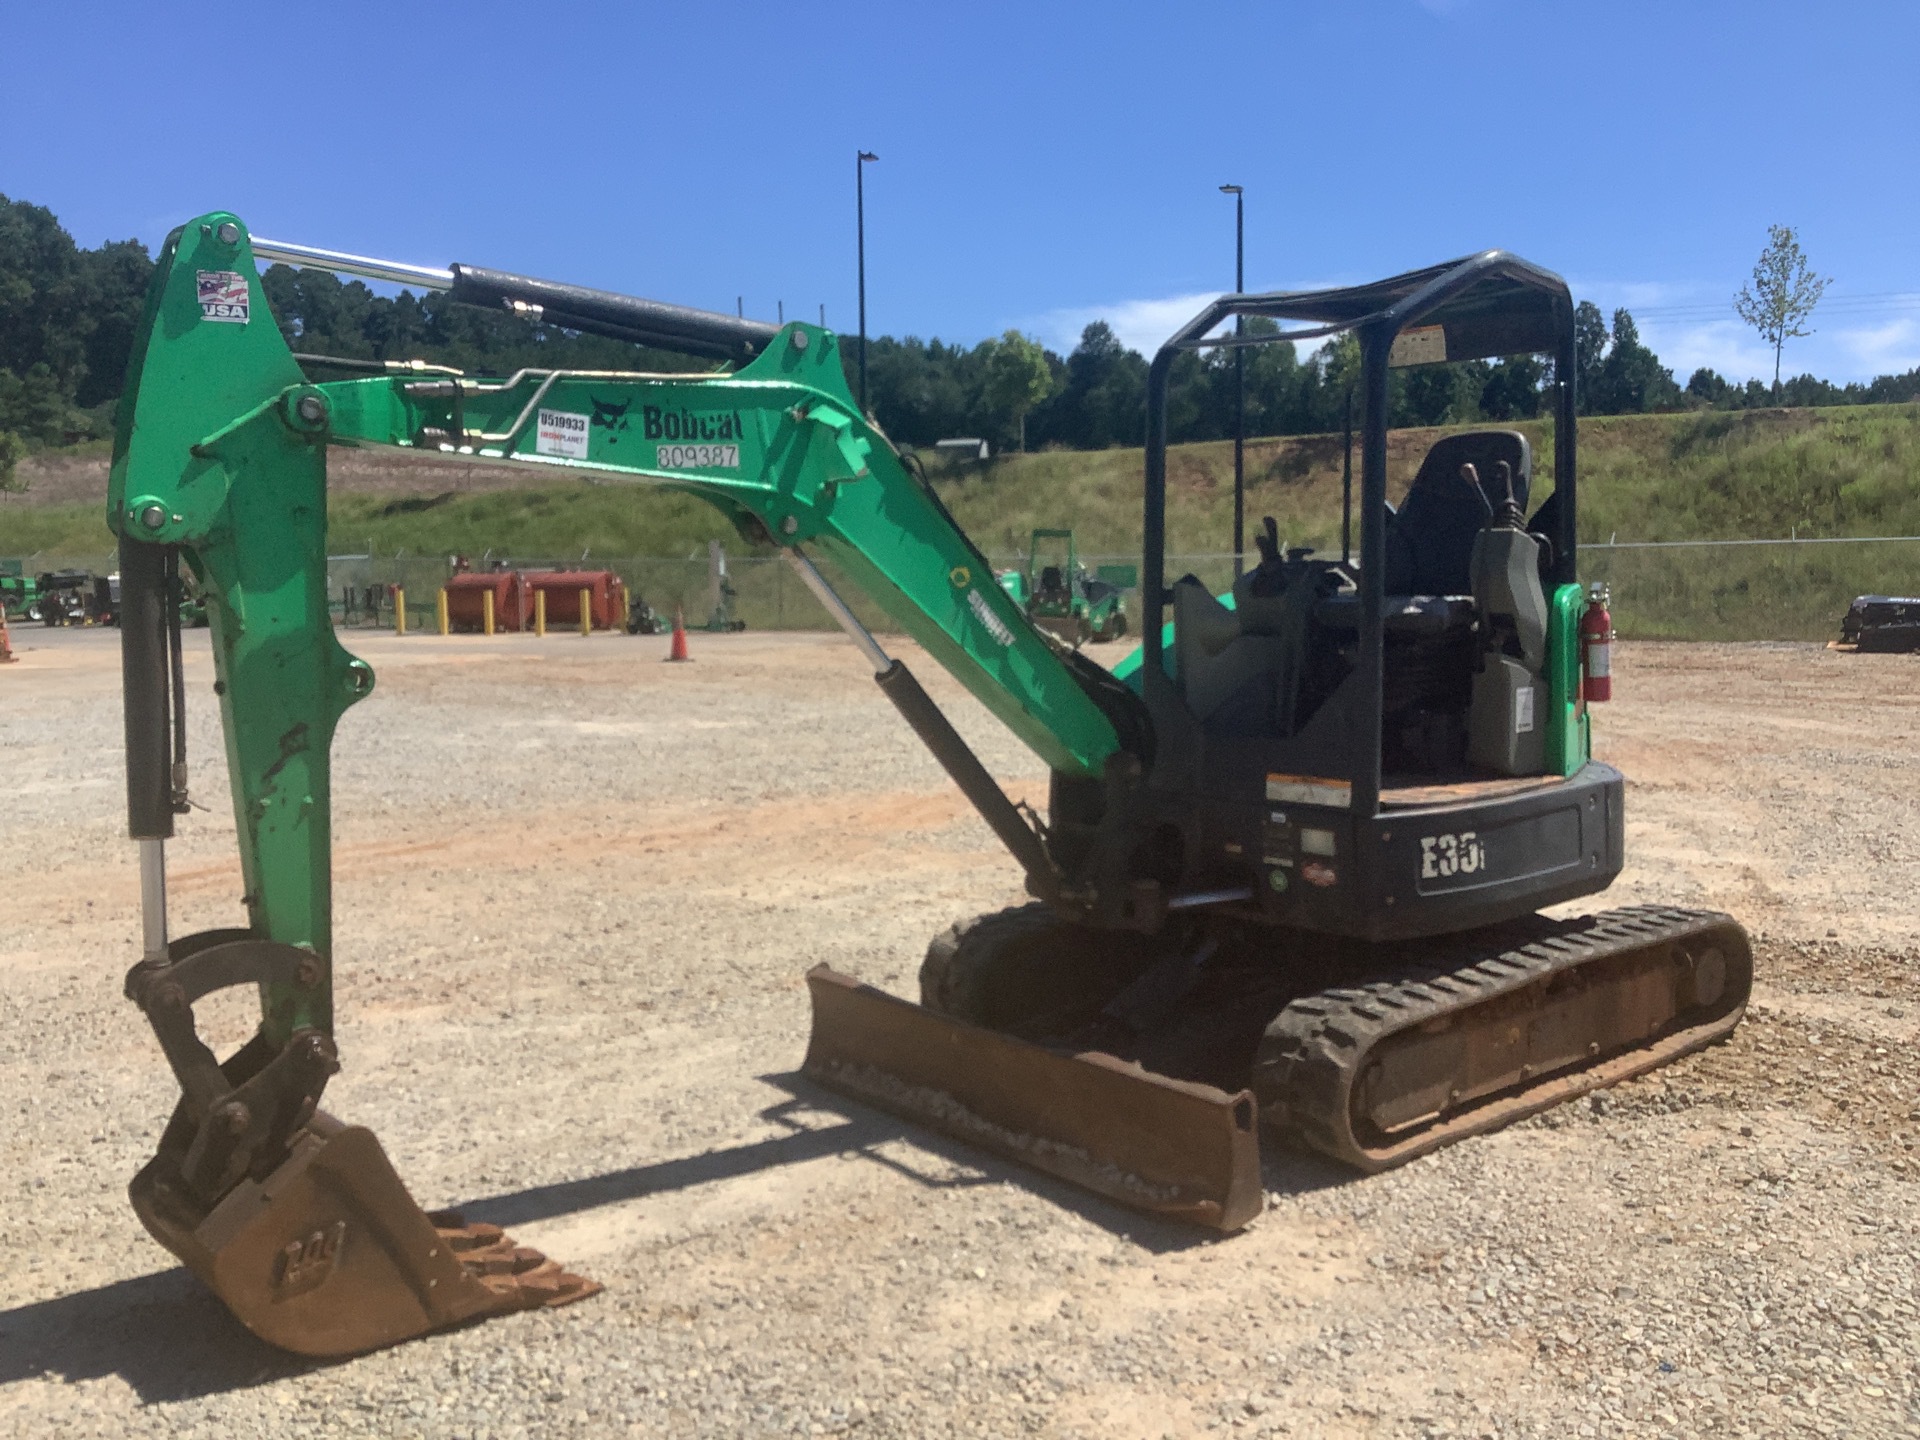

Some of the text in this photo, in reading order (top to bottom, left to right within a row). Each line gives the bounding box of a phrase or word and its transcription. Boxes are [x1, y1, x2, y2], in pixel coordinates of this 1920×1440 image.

[202, 304, 246, 318] USA
[541, 413, 585, 432] U519933
[658, 445, 736, 468] 809387
